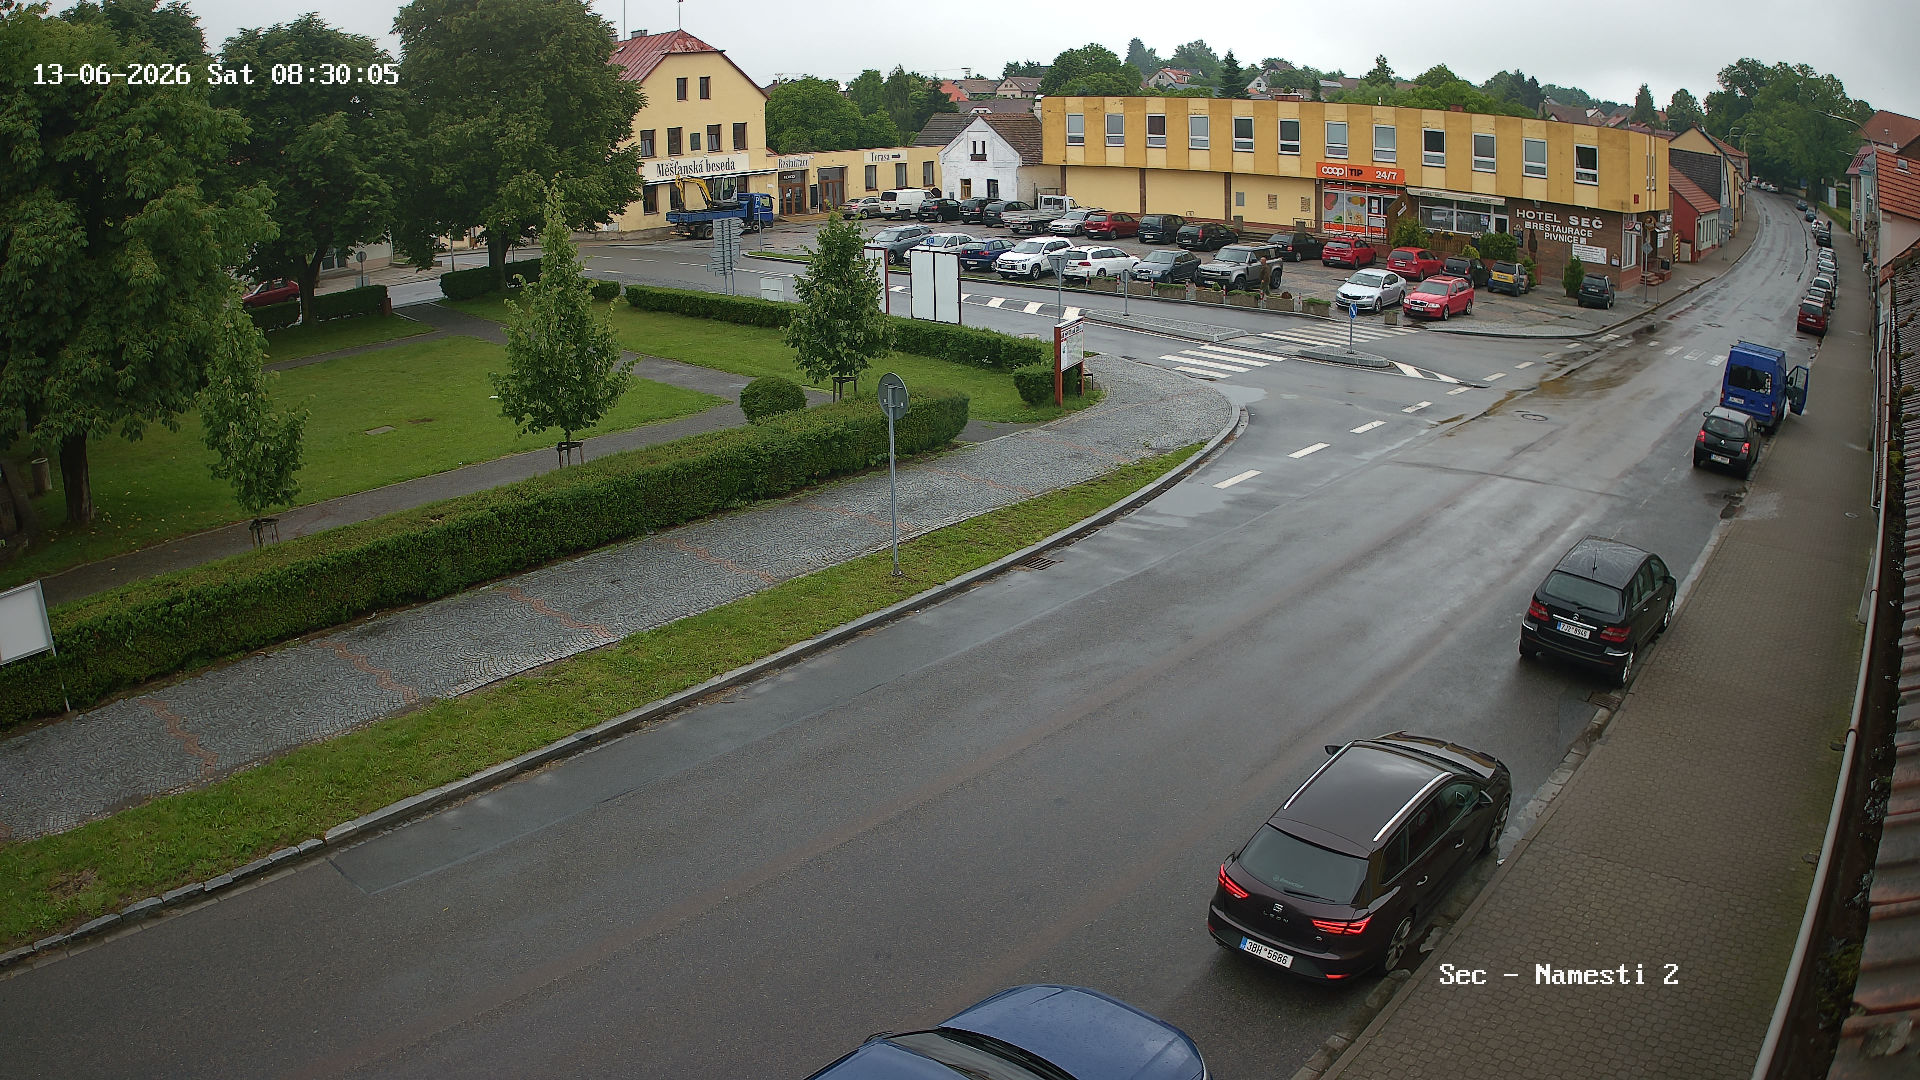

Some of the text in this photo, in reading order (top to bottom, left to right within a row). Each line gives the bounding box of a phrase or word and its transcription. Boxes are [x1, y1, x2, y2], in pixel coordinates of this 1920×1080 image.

[656, 158, 736, 178] Měšťanská beseda
[1349, 168, 1363, 176] TIP
[1375, 171, 1398, 180] 24/7
[1516, 208, 1603, 229] HOTEL SEČ
[1532, 221, 1593, 238] RESTAURACE
[1544, 232, 1579, 244] PIVNICE
